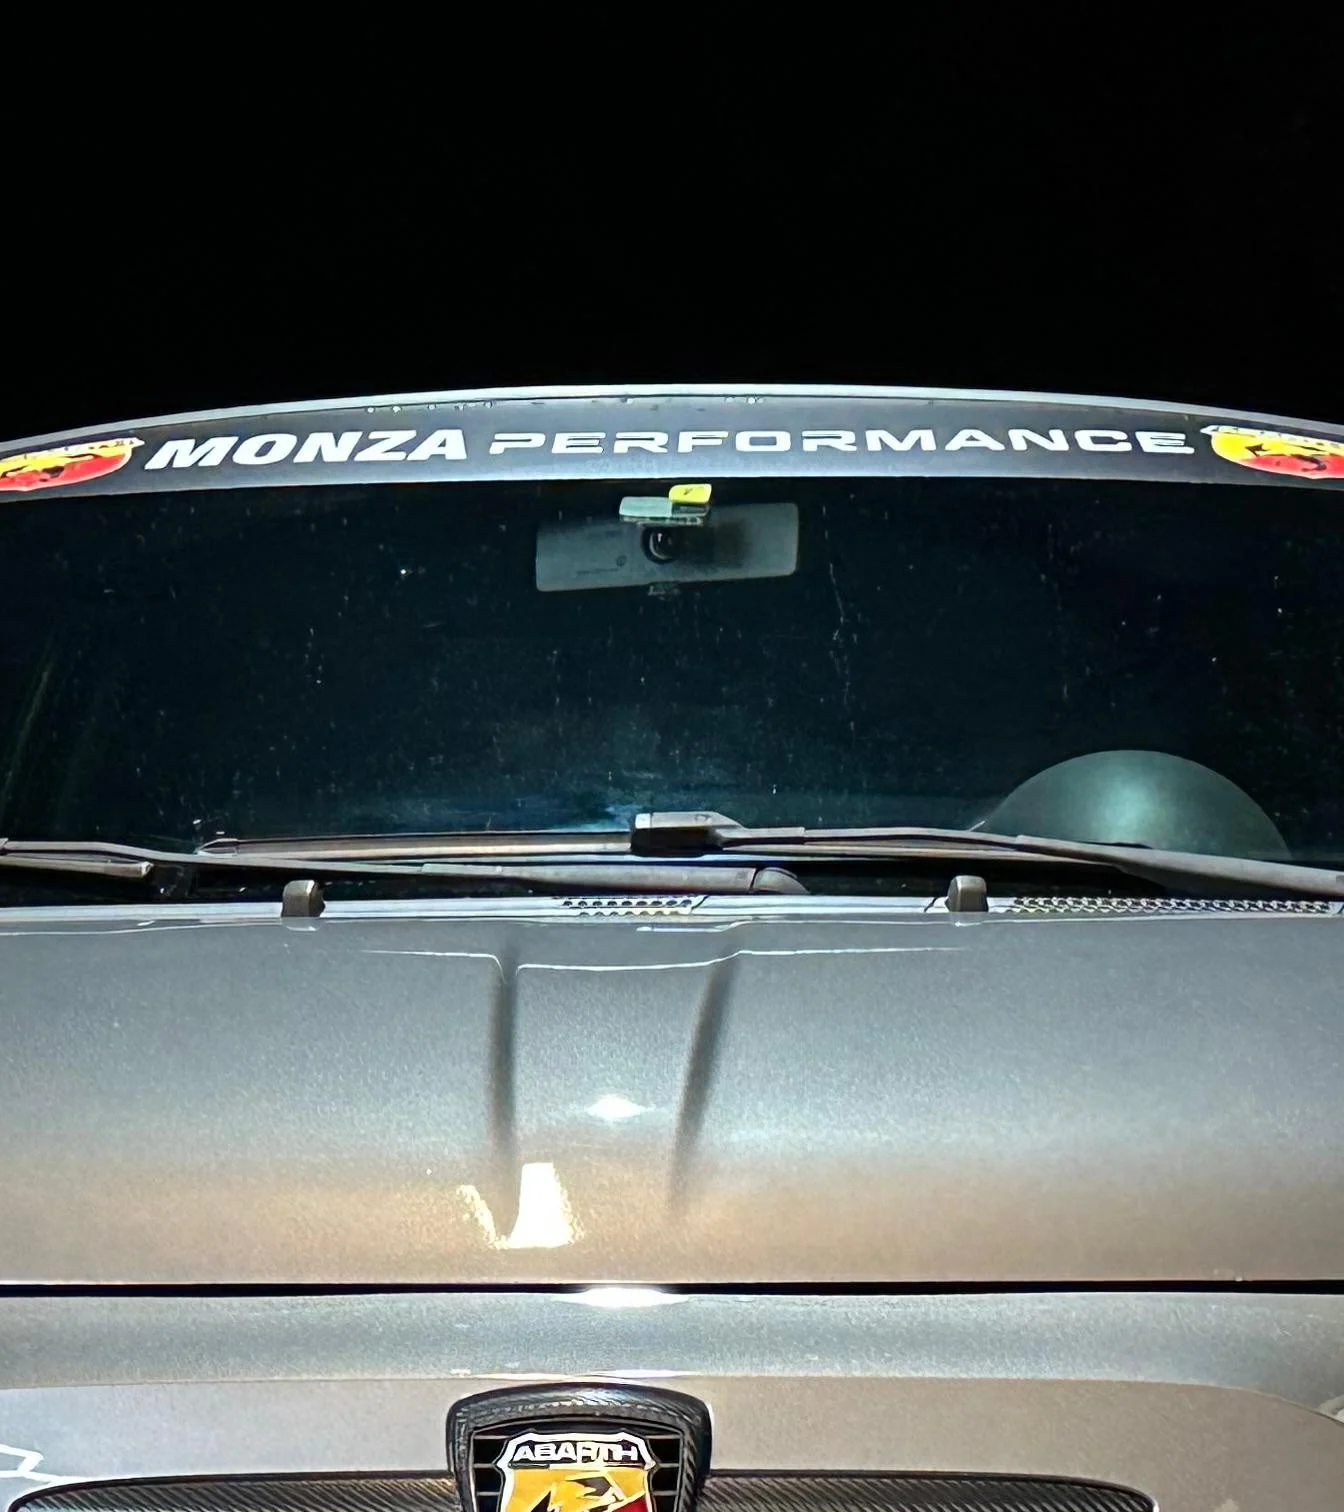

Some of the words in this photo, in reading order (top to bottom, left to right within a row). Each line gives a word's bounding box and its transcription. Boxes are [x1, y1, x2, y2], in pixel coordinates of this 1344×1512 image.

[144, 428, 468, 470] MONZA
[488, 428, 1196, 456] PERFORMANCE
[514, 1441, 639, 1464] ABARTH
